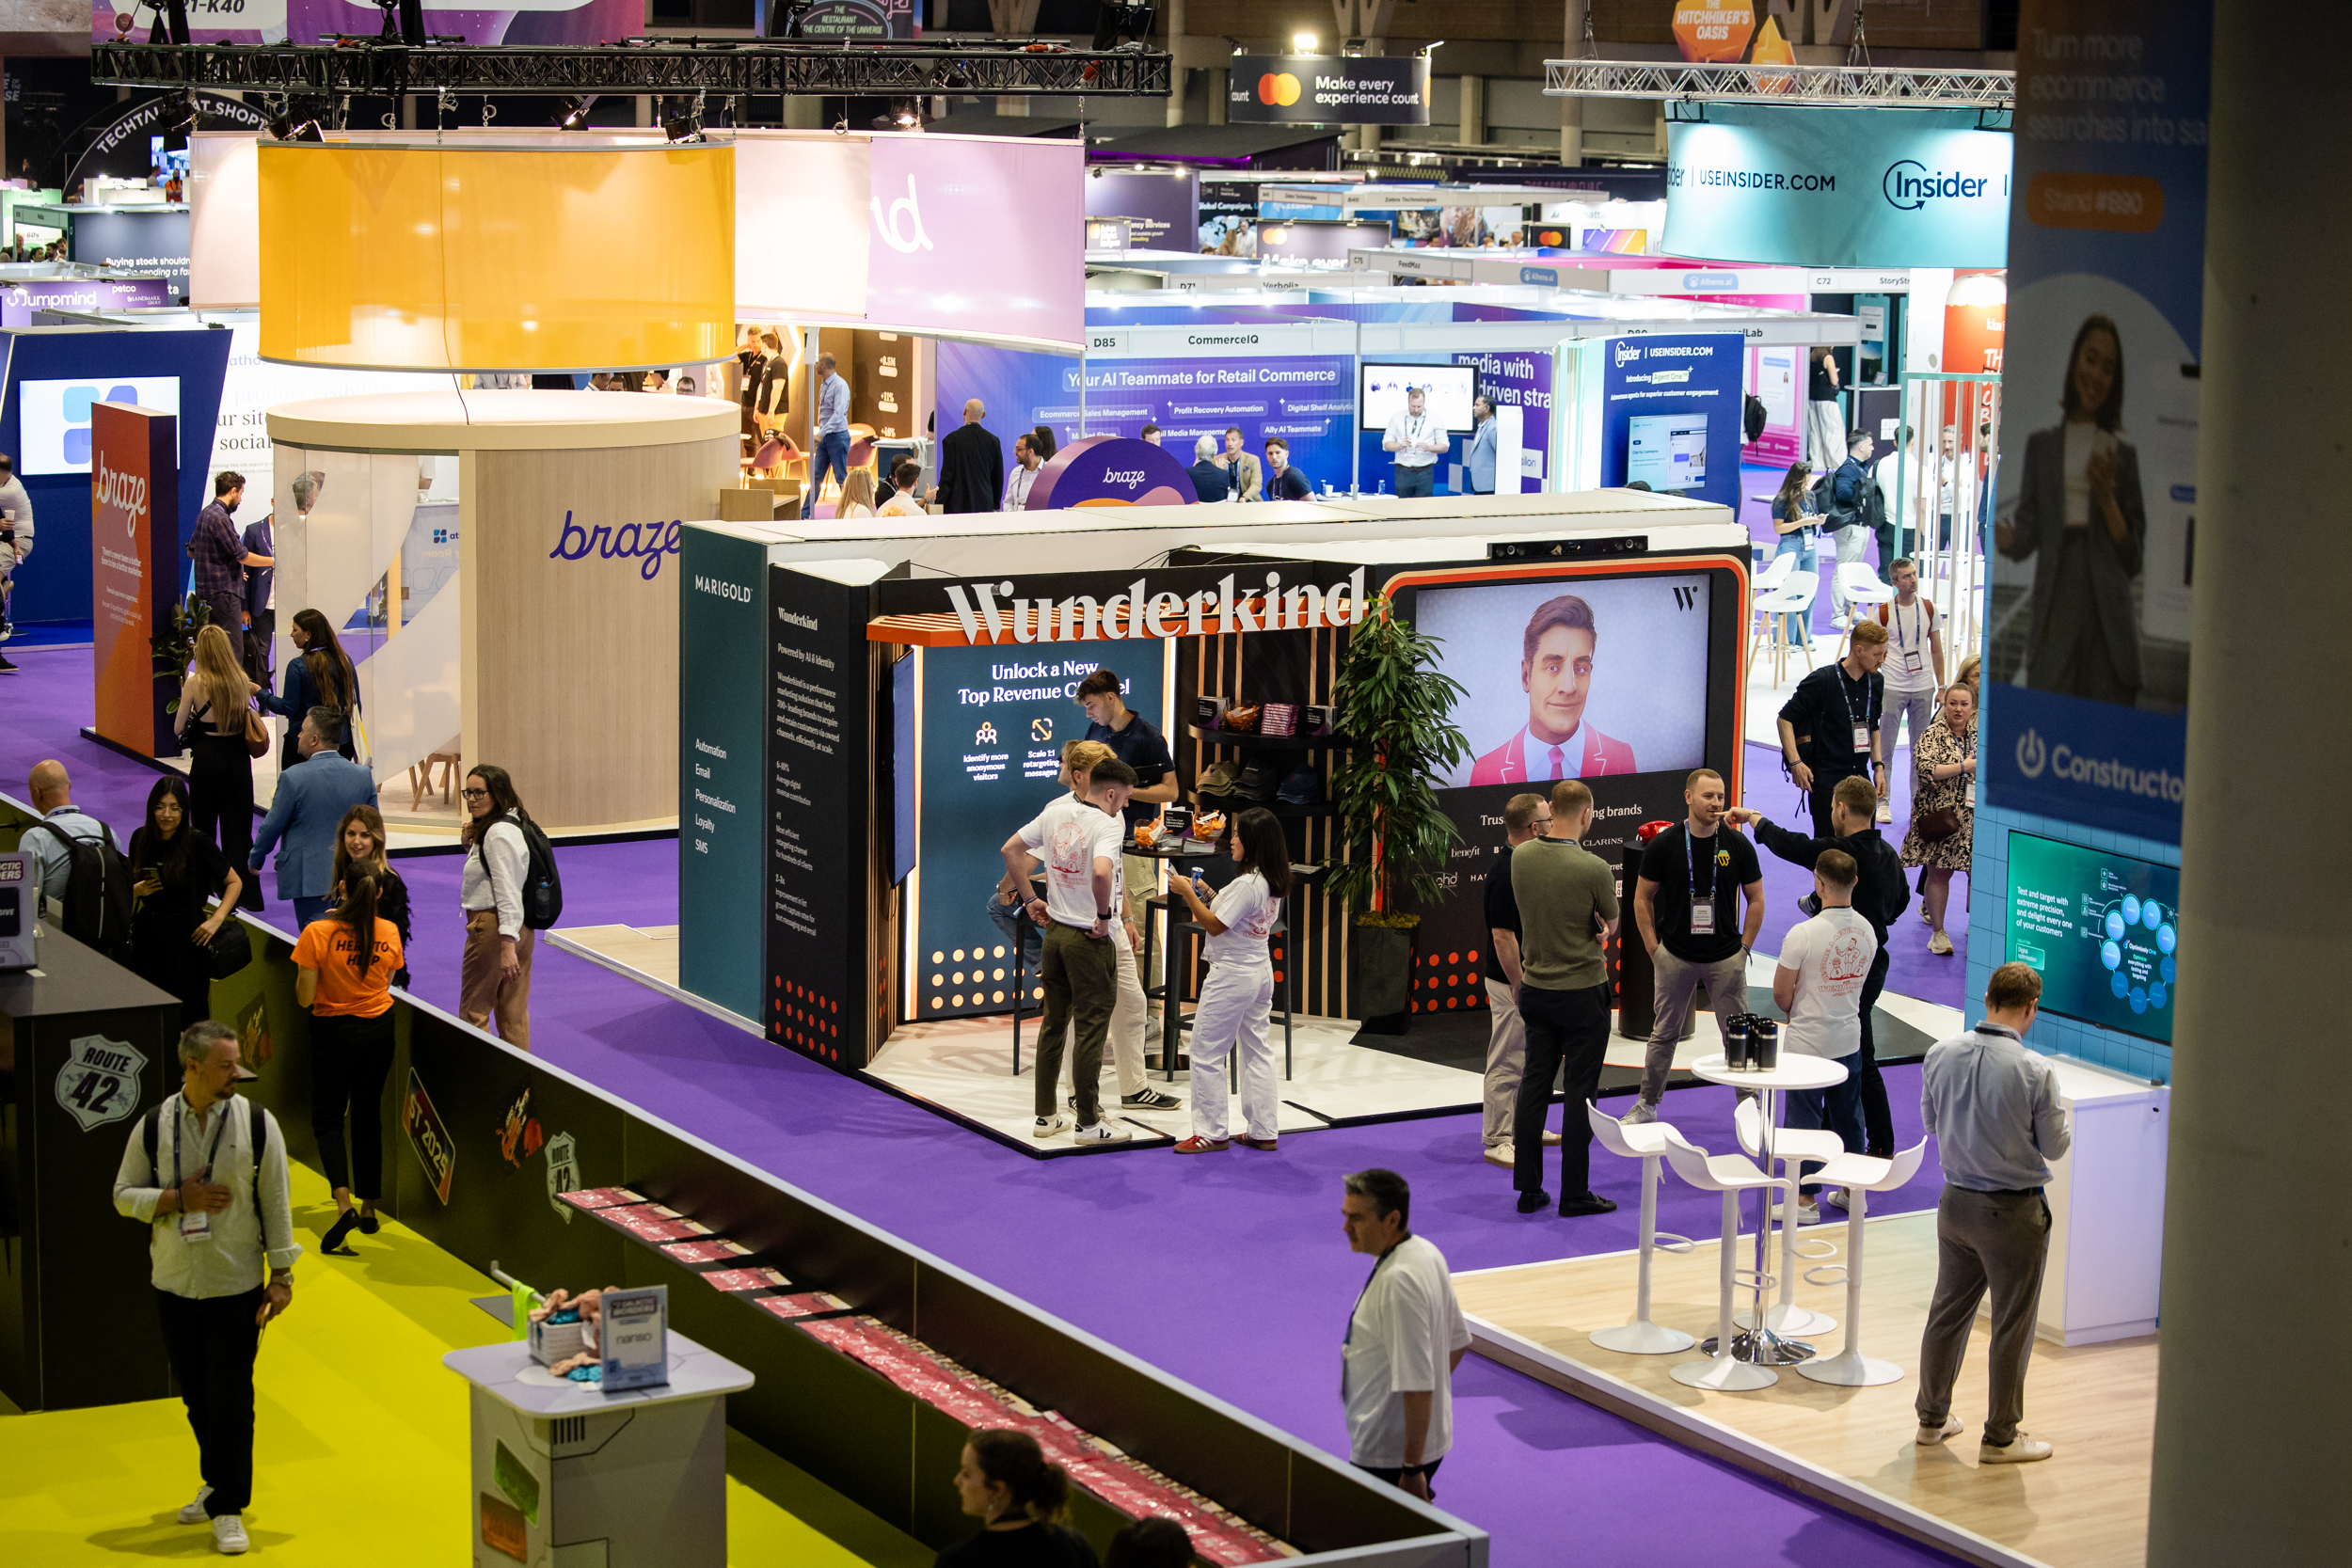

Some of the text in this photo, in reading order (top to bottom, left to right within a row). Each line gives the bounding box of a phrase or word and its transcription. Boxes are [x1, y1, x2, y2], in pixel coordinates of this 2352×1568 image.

[834, 6, 845, 14] THE
[1677, 10, 1750, 25] HITCHHIKER'S
[814, 25, 835, 34] CENTRE
[836, 25, 845, 34] OF
[857, 25, 883, 34] UNIVERSE
[1696, 25, 1729, 40] OASIS
[1315, 76, 1394, 93] Make every
[1232, 90, 1249, 102] count
[1315, 91, 1419, 106] experience count
[1699, 170, 1836, 192] USEINSIDER.COM
[1896, 171, 1988, 198] Insider
[105, 257, 135, 268] Buying
[135, 257, 158, 265] stock
[1398, 261, 1421, 269] FeedMax
[112, 284, 136, 294] petco
[22, 291, 97, 309] Jumpmind
[1093, 334, 1260, 348] D85 CommerceIQ
[1617, 345, 1713, 361] Insider USEINSIDER.COM
[1503, 356, 1534, 380] with
[1102, 372, 1119, 387] AI
[1120, 371, 1194, 386] Teammate
[1196, 370, 1216, 384] for
[1217, 369, 1256, 383] Retail
[1259, 368, 1336, 383] Commerce
[1653, 372, 1670, 382] Agent
[1480, 378, 1520, 404] driven
[1686, 389, 1719, 398] engagement
[1101, 408, 1148, 420] Management
[1174, 404, 1263, 417] Profit Recovery Automation
[1287, 403, 1355, 414] Digital Shelf Analytic
[242, 409, 263, 426] sit
[1168, 428, 1187, 437] Media
[1189, 428, 1226, 439] Manageme
[1264, 425, 1277, 436] Ally
[1285, 425, 1322, 434] Teammate
[219, 434, 272, 451] social
[1103, 467, 1146, 489] braze
[96, 450, 146, 538] braze
[549, 510, 681, 580] braze
[695, 575, 751, 603] MARIGOLD
[944, 565, 1365, 645] Wunderkind
[777, 607, 818, 631] Wunderkind
[777, 642, 798, 658] Powered
[799, 650, 805, 662] by
[816, 654, 834, 671] Identity
[992, 660, 1099, 680] Unlock a New
[958, 689, 990, 706] Top
[993, 687, 1061, 703] Revenue
[695, 738, 726, 759] Automation
[1027, 750, 1043, 758] Scale
[963, 753, 990, 764] Identify
[1023, 759, 1060, 769] retargeting
[695, 763, 710, 779] Email
[966, 763, 1006, 773] anonymous
[1025, 769, 1057, 779] messages
[973, 772, 998, 781] visitors
[695, 788, 736, 814] Personalization
[1607, 803, 1643, 817] brands
[695, 814, 715, 833] Loyalty
[1480, 815, 1505, 826] Trus
[695, 838, 708, 854] SMS
[1582, 837, 1624, 847] CLARINS
[1451, 846, 1480, 858] benefit
[2017, 886, 2069, 906] Test and target with
[2016, 898, 2065, 917] extreme precision,
[2016, 909, 2026, 917] and
[2027, 911, 2045, 922] delight
[2046, 916, 2061, 927] every
[2036, 925, 2063, 937] customers
[346, 954, 380, 966] HP
[83, 1046, 132, 1072] ROUTE
[71, 1073, 120, 1115] 42
[421, 1119, 449, 1180] 2025
[551, 1144, 570, 1165] ROUTE
